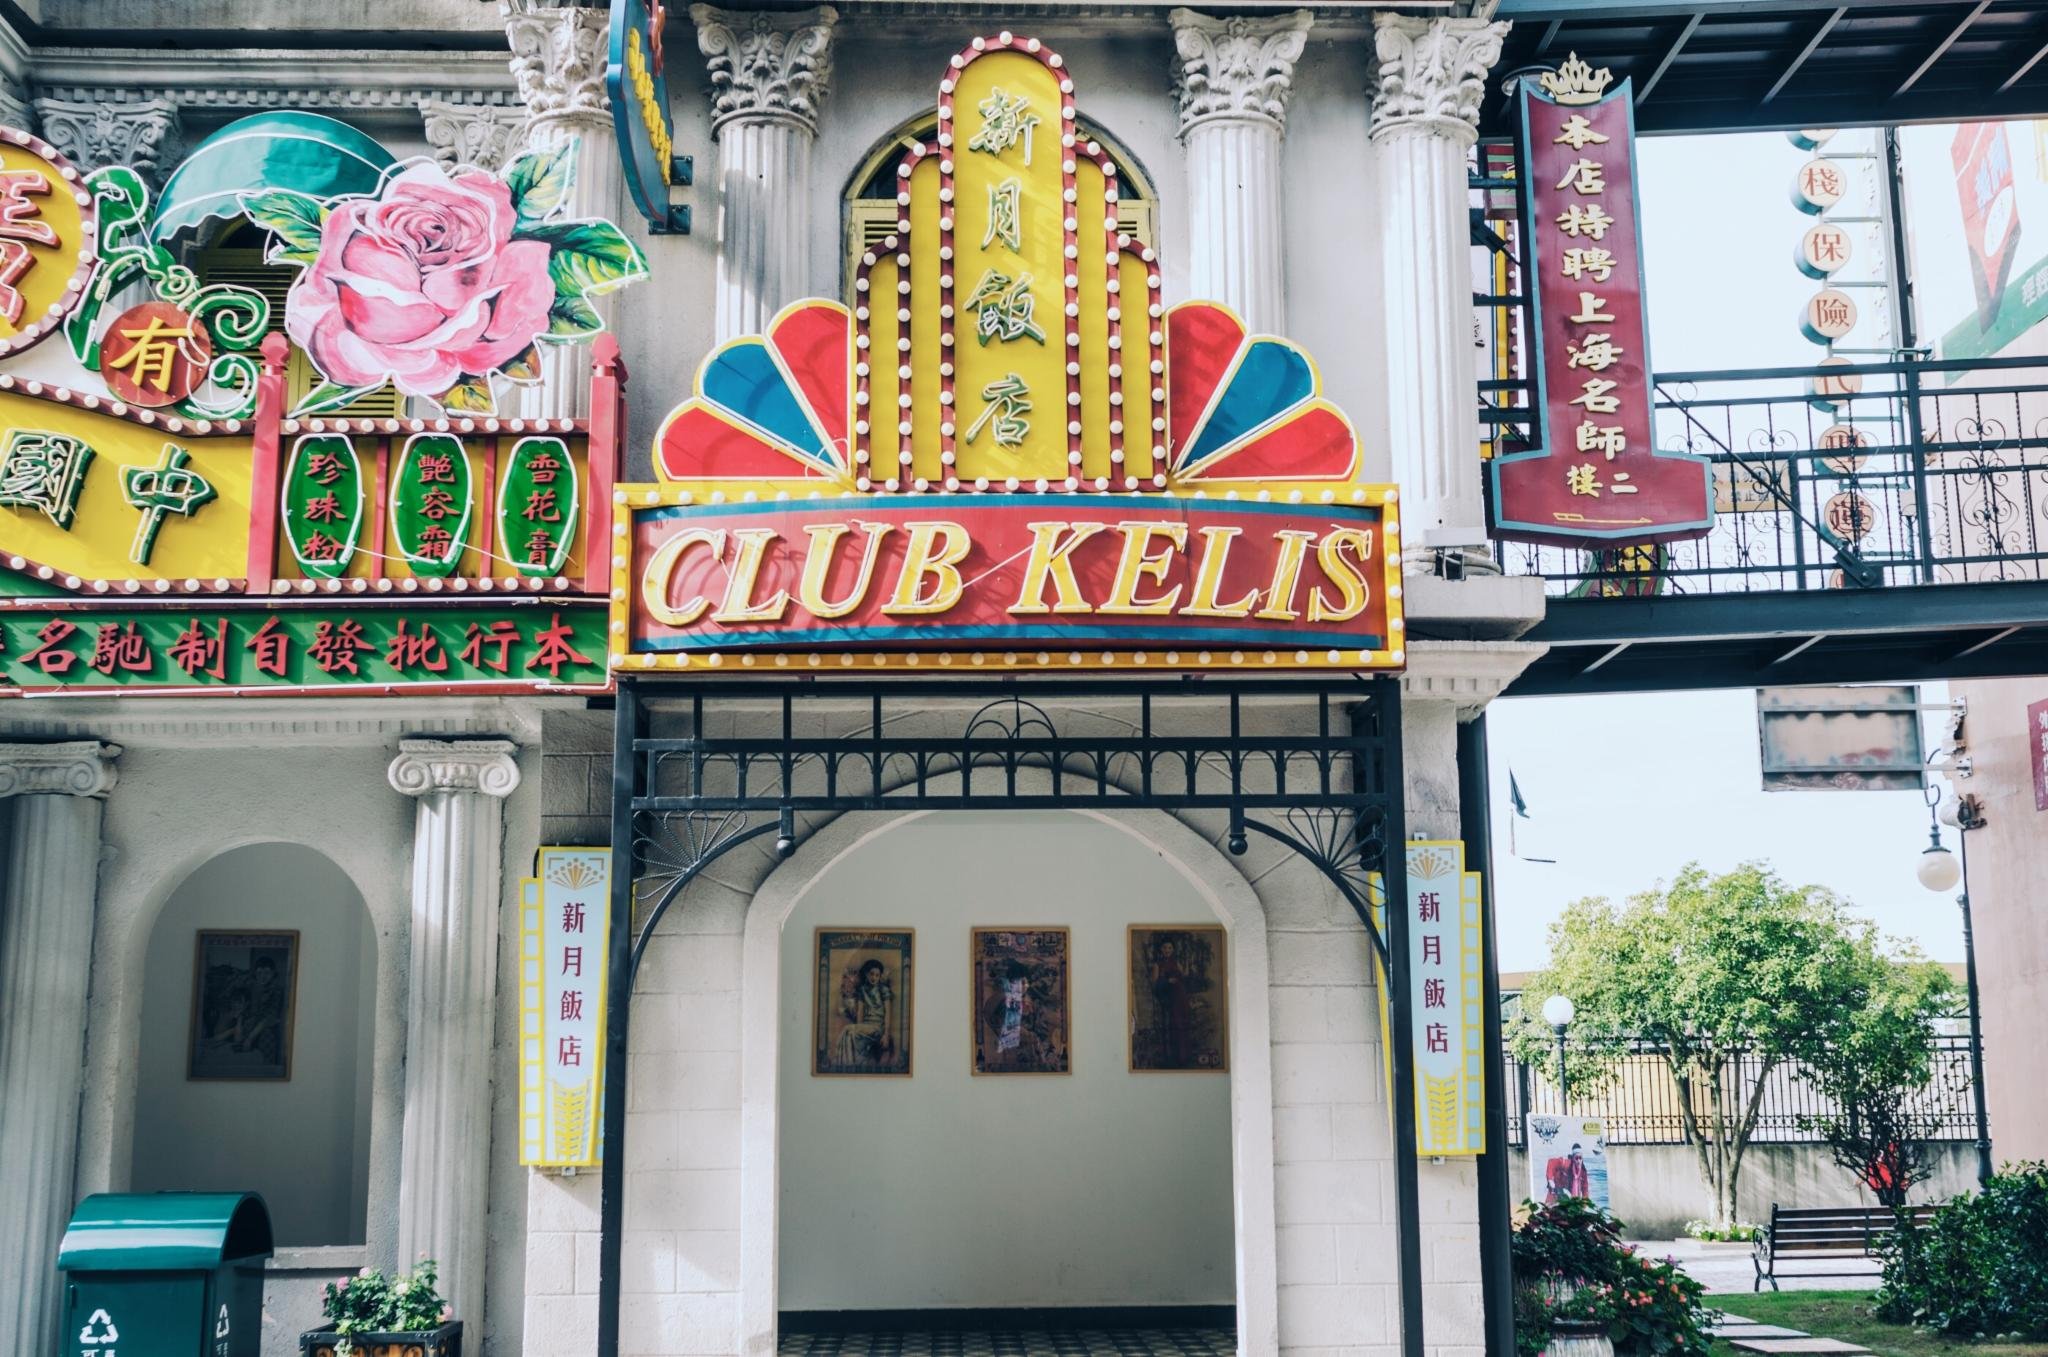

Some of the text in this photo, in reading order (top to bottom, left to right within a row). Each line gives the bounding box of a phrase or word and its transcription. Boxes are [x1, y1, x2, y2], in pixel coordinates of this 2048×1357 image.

[964, 85, 1046, 449] 新月飯店
[1553, 114, 1626, 461] 本店特聘上海名師
[109, 317, 193, 393] 有
[302, 452, 349, 561] 珍珠粉
[522, 454, 561, 567] 雪花膏
[641, 519, 1374, 626] CLUB KELIS
[0, 612, 593, 678] 本行批發自制馳名
[557, 901, 587, 1067] 新月飯店
[1418, 891, 1449, 1055] 新月飯店
